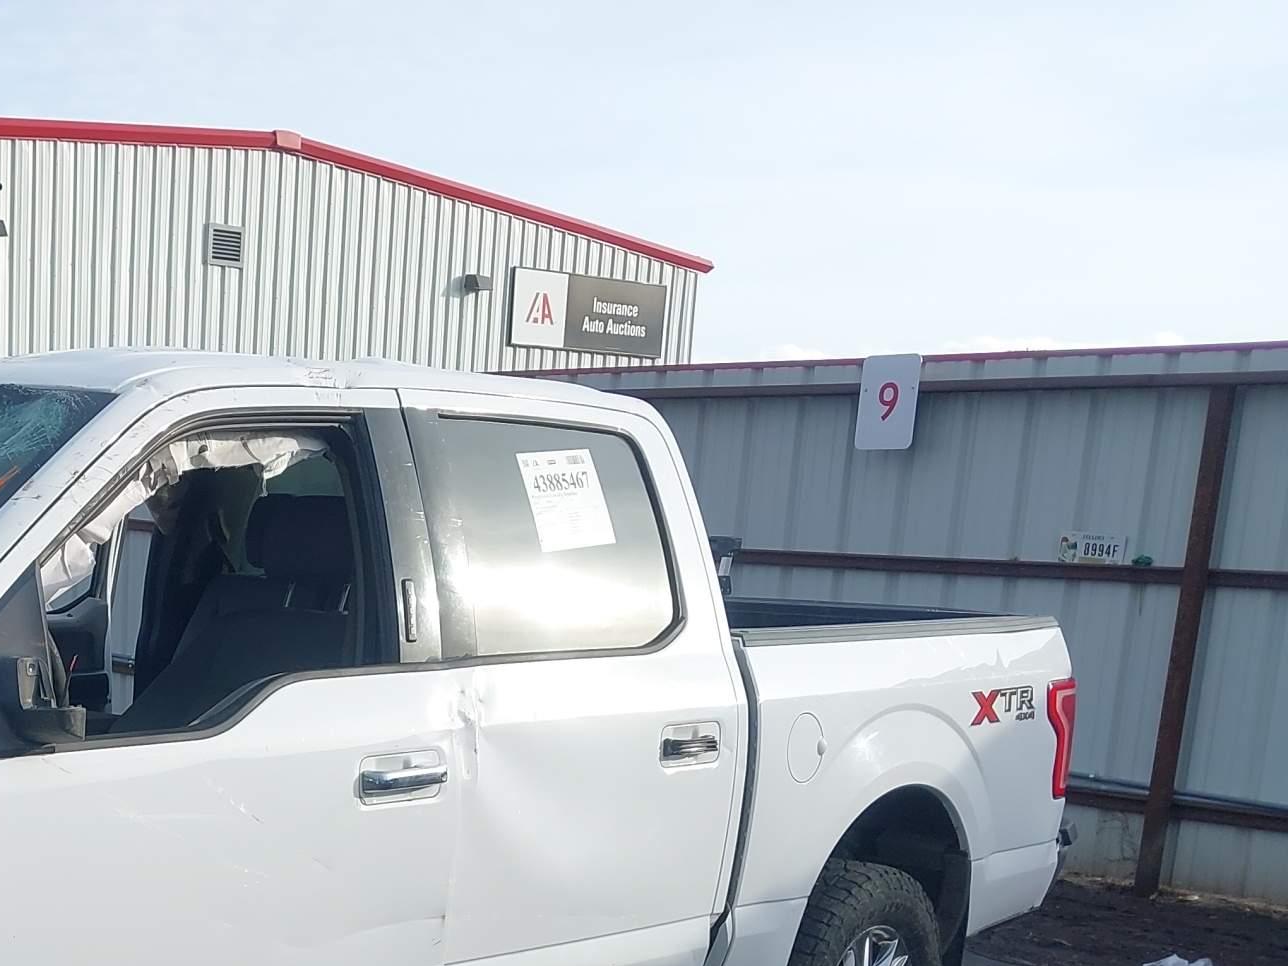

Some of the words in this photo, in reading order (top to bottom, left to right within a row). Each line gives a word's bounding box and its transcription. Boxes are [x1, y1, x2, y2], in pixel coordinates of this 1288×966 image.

[593, 297, 639, 318] Insurance
[582, 316, 604, 334] Auto
[606, 318, 646, 338] Auctions
[878, 382, 899, 421] 9
[533, 471, 590, 492] 43885467
[970, 685, 1035, 727] XTR
